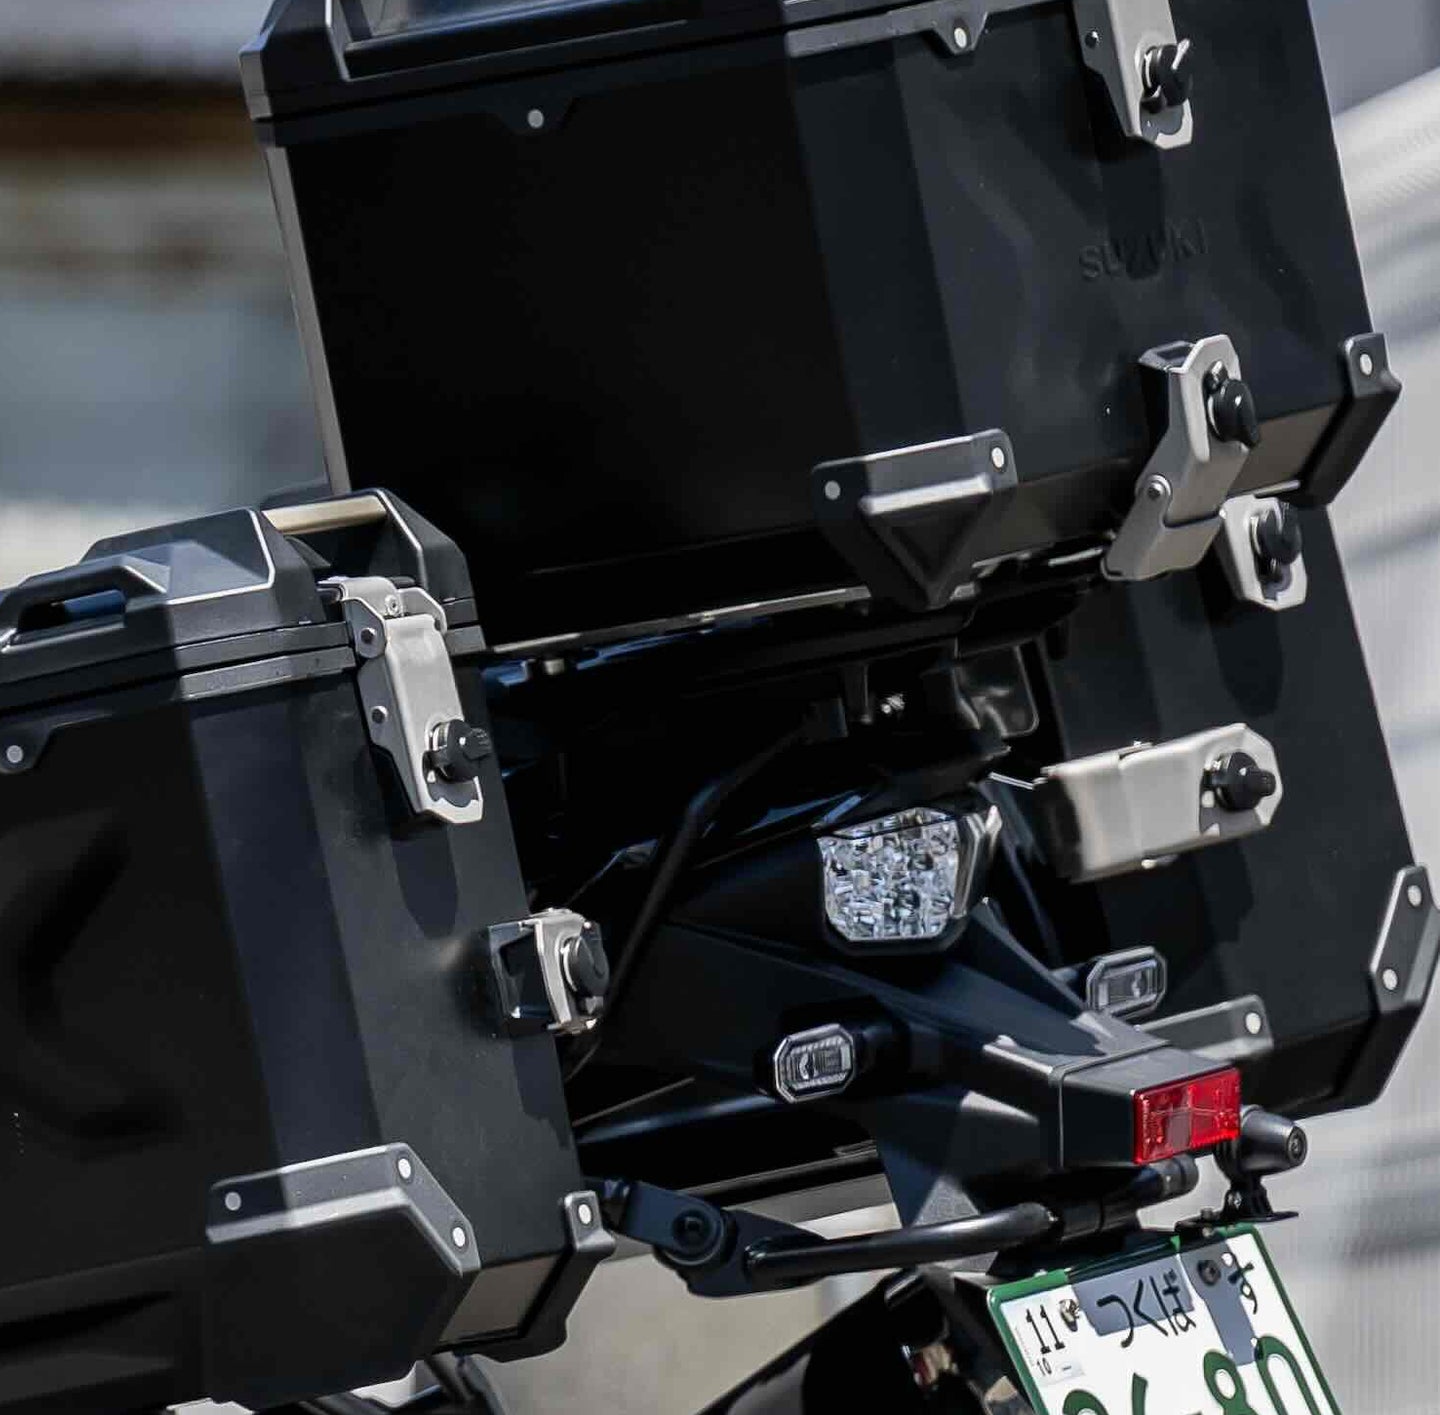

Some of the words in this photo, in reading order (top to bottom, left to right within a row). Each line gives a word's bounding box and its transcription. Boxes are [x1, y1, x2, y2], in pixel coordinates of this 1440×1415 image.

[1026, 1304, 1066, 1354] 11
[1096, 1268, 1197, 1348] つくば
